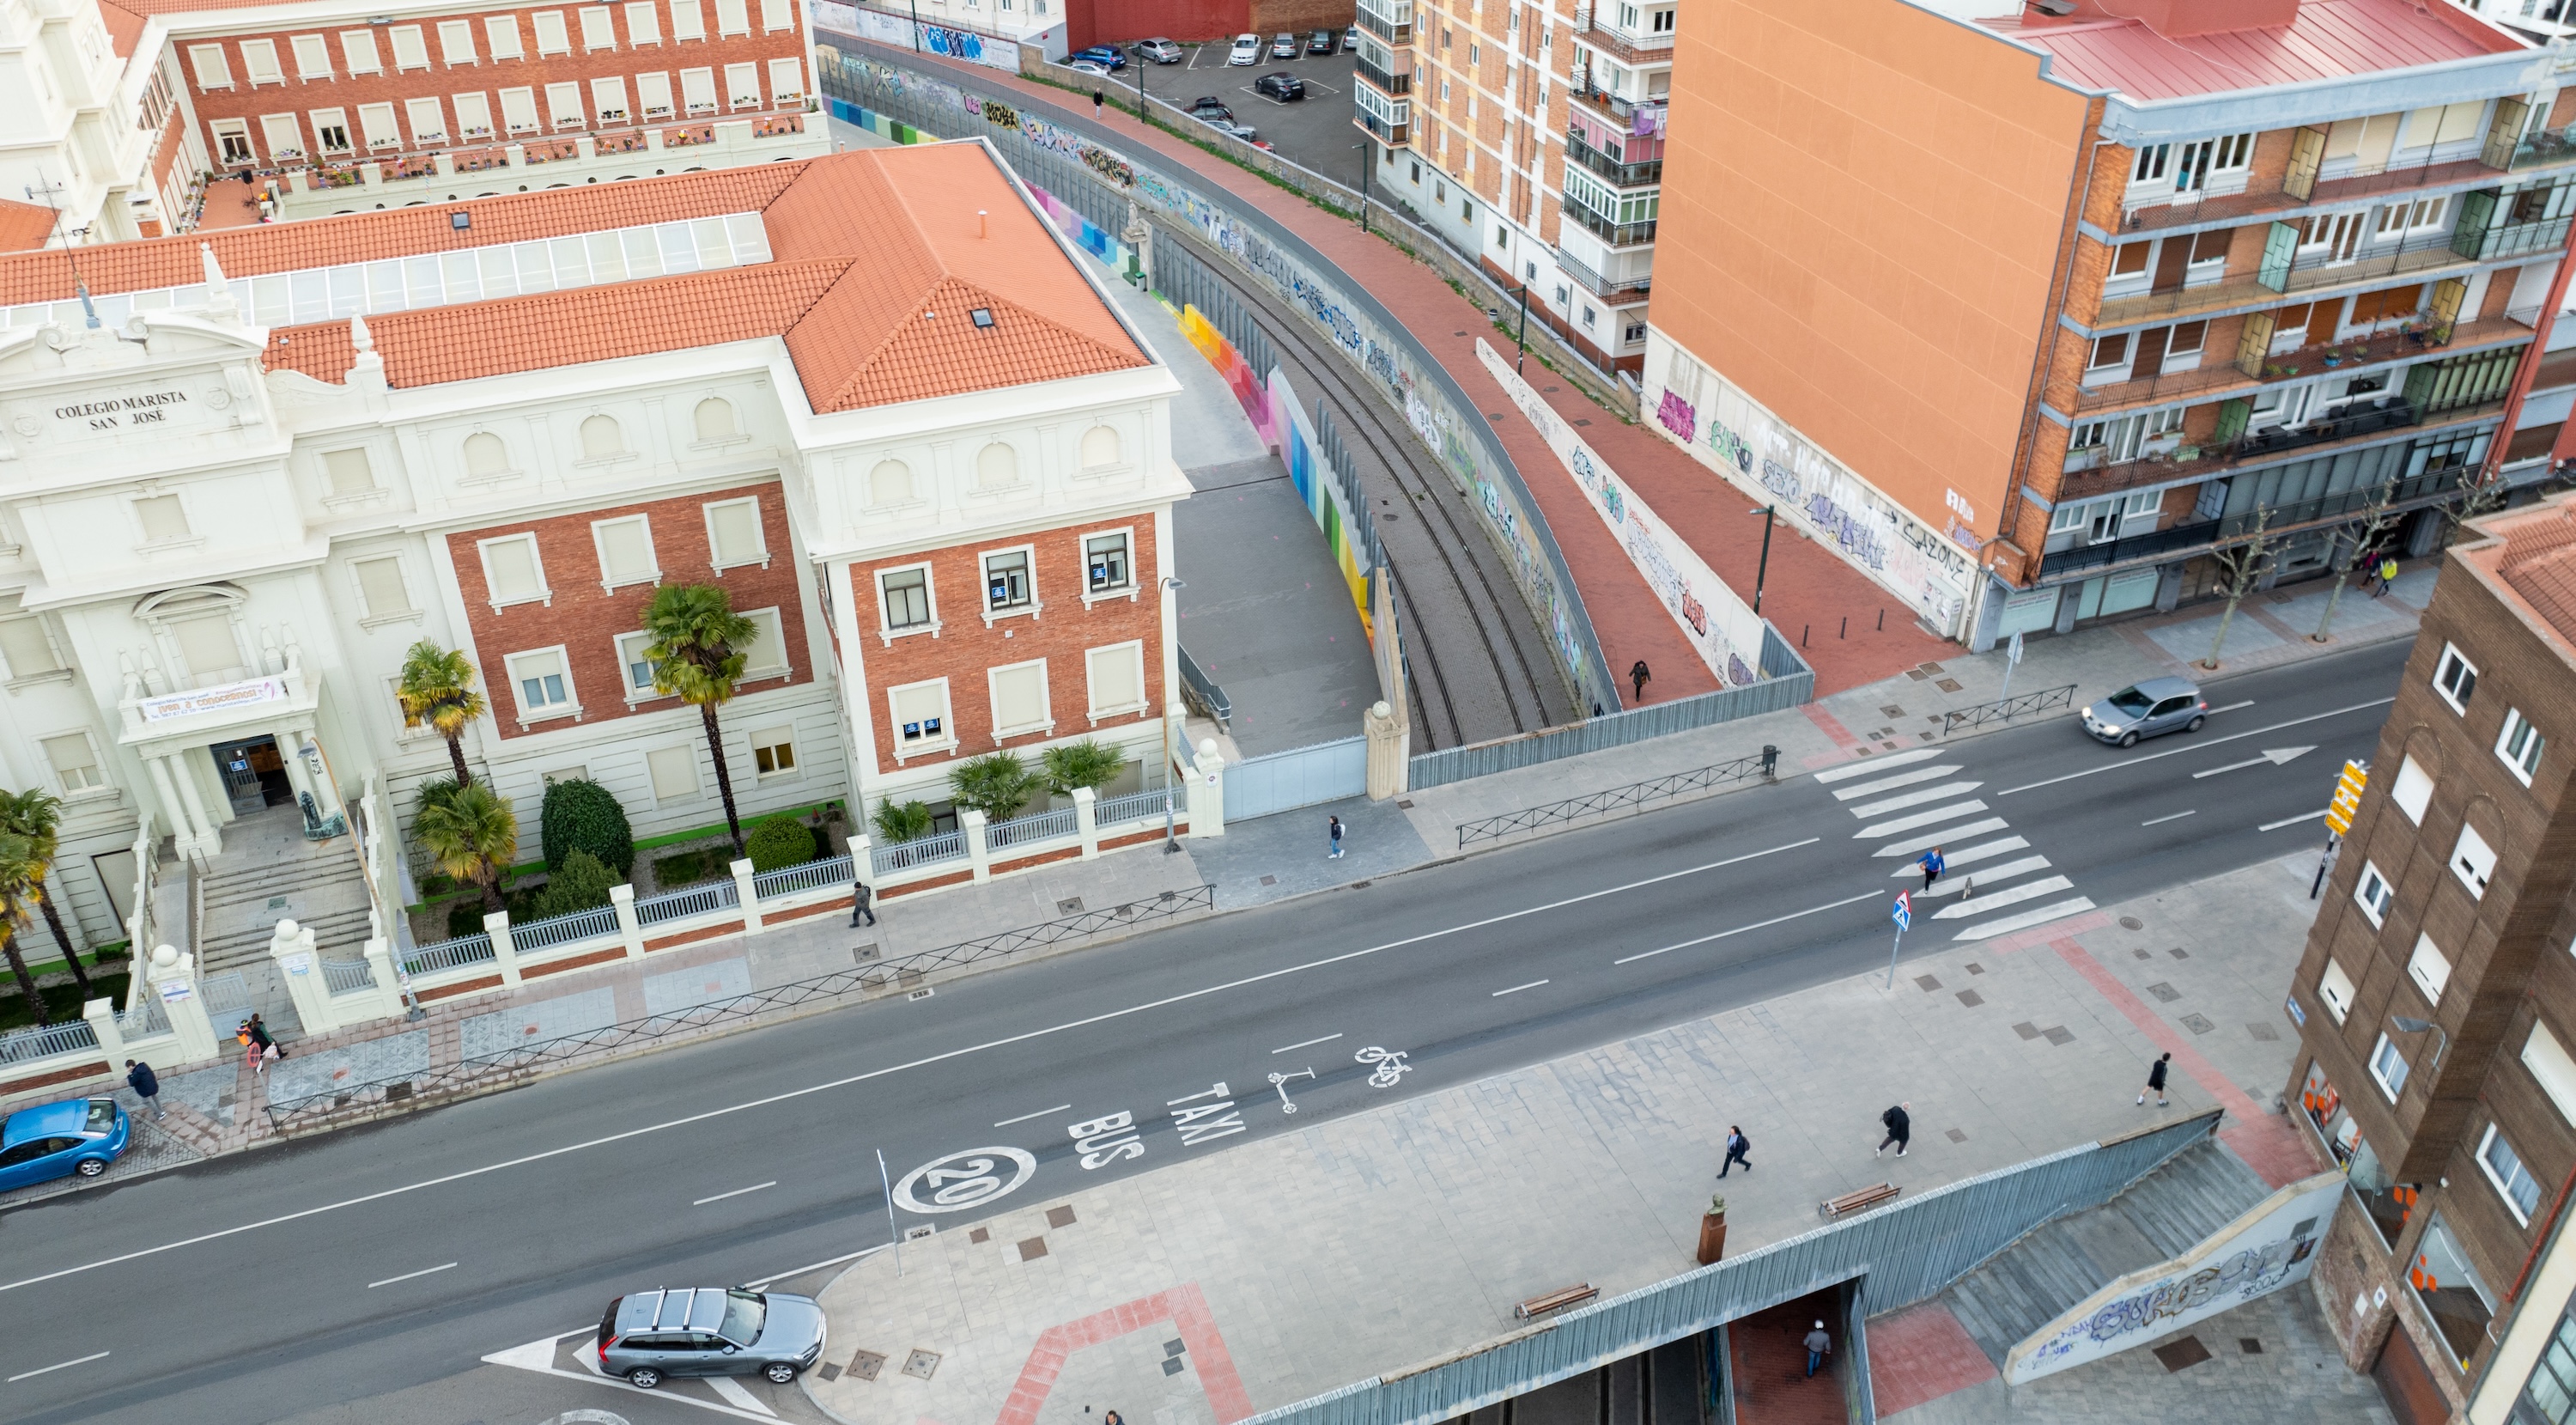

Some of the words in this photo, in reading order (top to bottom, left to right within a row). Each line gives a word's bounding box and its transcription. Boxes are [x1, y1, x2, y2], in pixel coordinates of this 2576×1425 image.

[55, 400, 120, 420] COLEGIO
[122, 391, 187, 411] MARISTA
[89, 417, 118, 431] SAN
[133, 406, 166, 425] JOSÉ
[1166, 1081, 1247, 1147] TAXI
[1067, 1110, 1145, 1171] BUS
[926, 1158, 1000, 1205] 20
